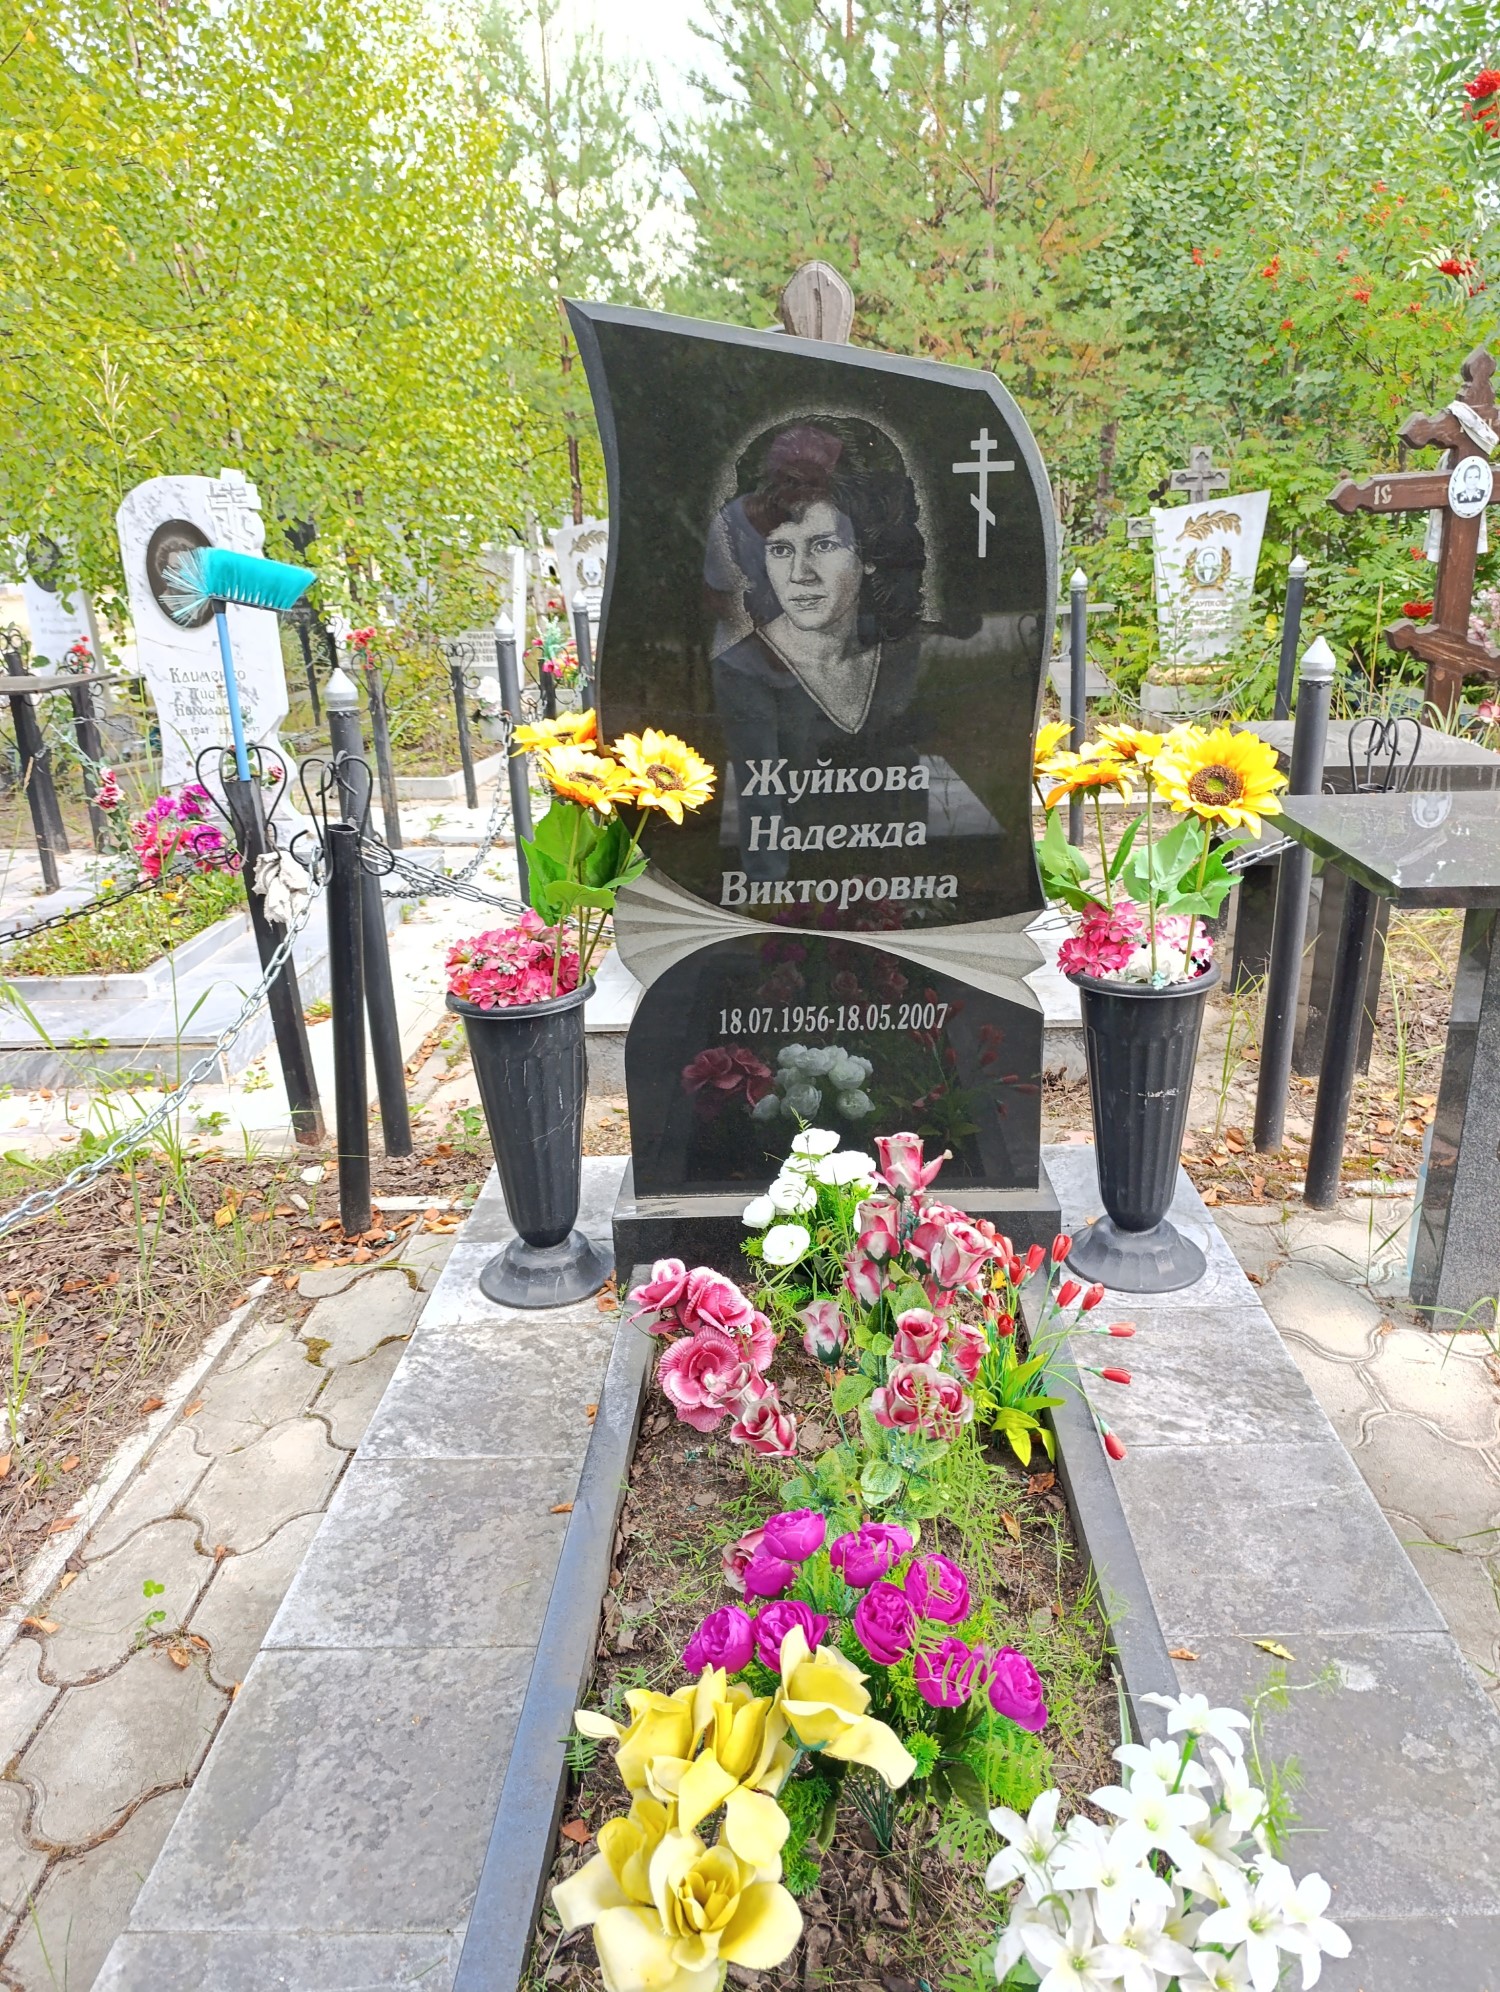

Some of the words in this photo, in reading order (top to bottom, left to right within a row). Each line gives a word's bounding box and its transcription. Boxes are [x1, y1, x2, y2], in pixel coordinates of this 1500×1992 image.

[169, 667, 246, 683] Климено
[741, 758, 930, 804] Жуйкова
[748, 815, 927, 851] Надежда
[720, 871, 959, 910] Викторовна
[719, 1003, 949, 1035] 18.07.1956-18.05.2007
